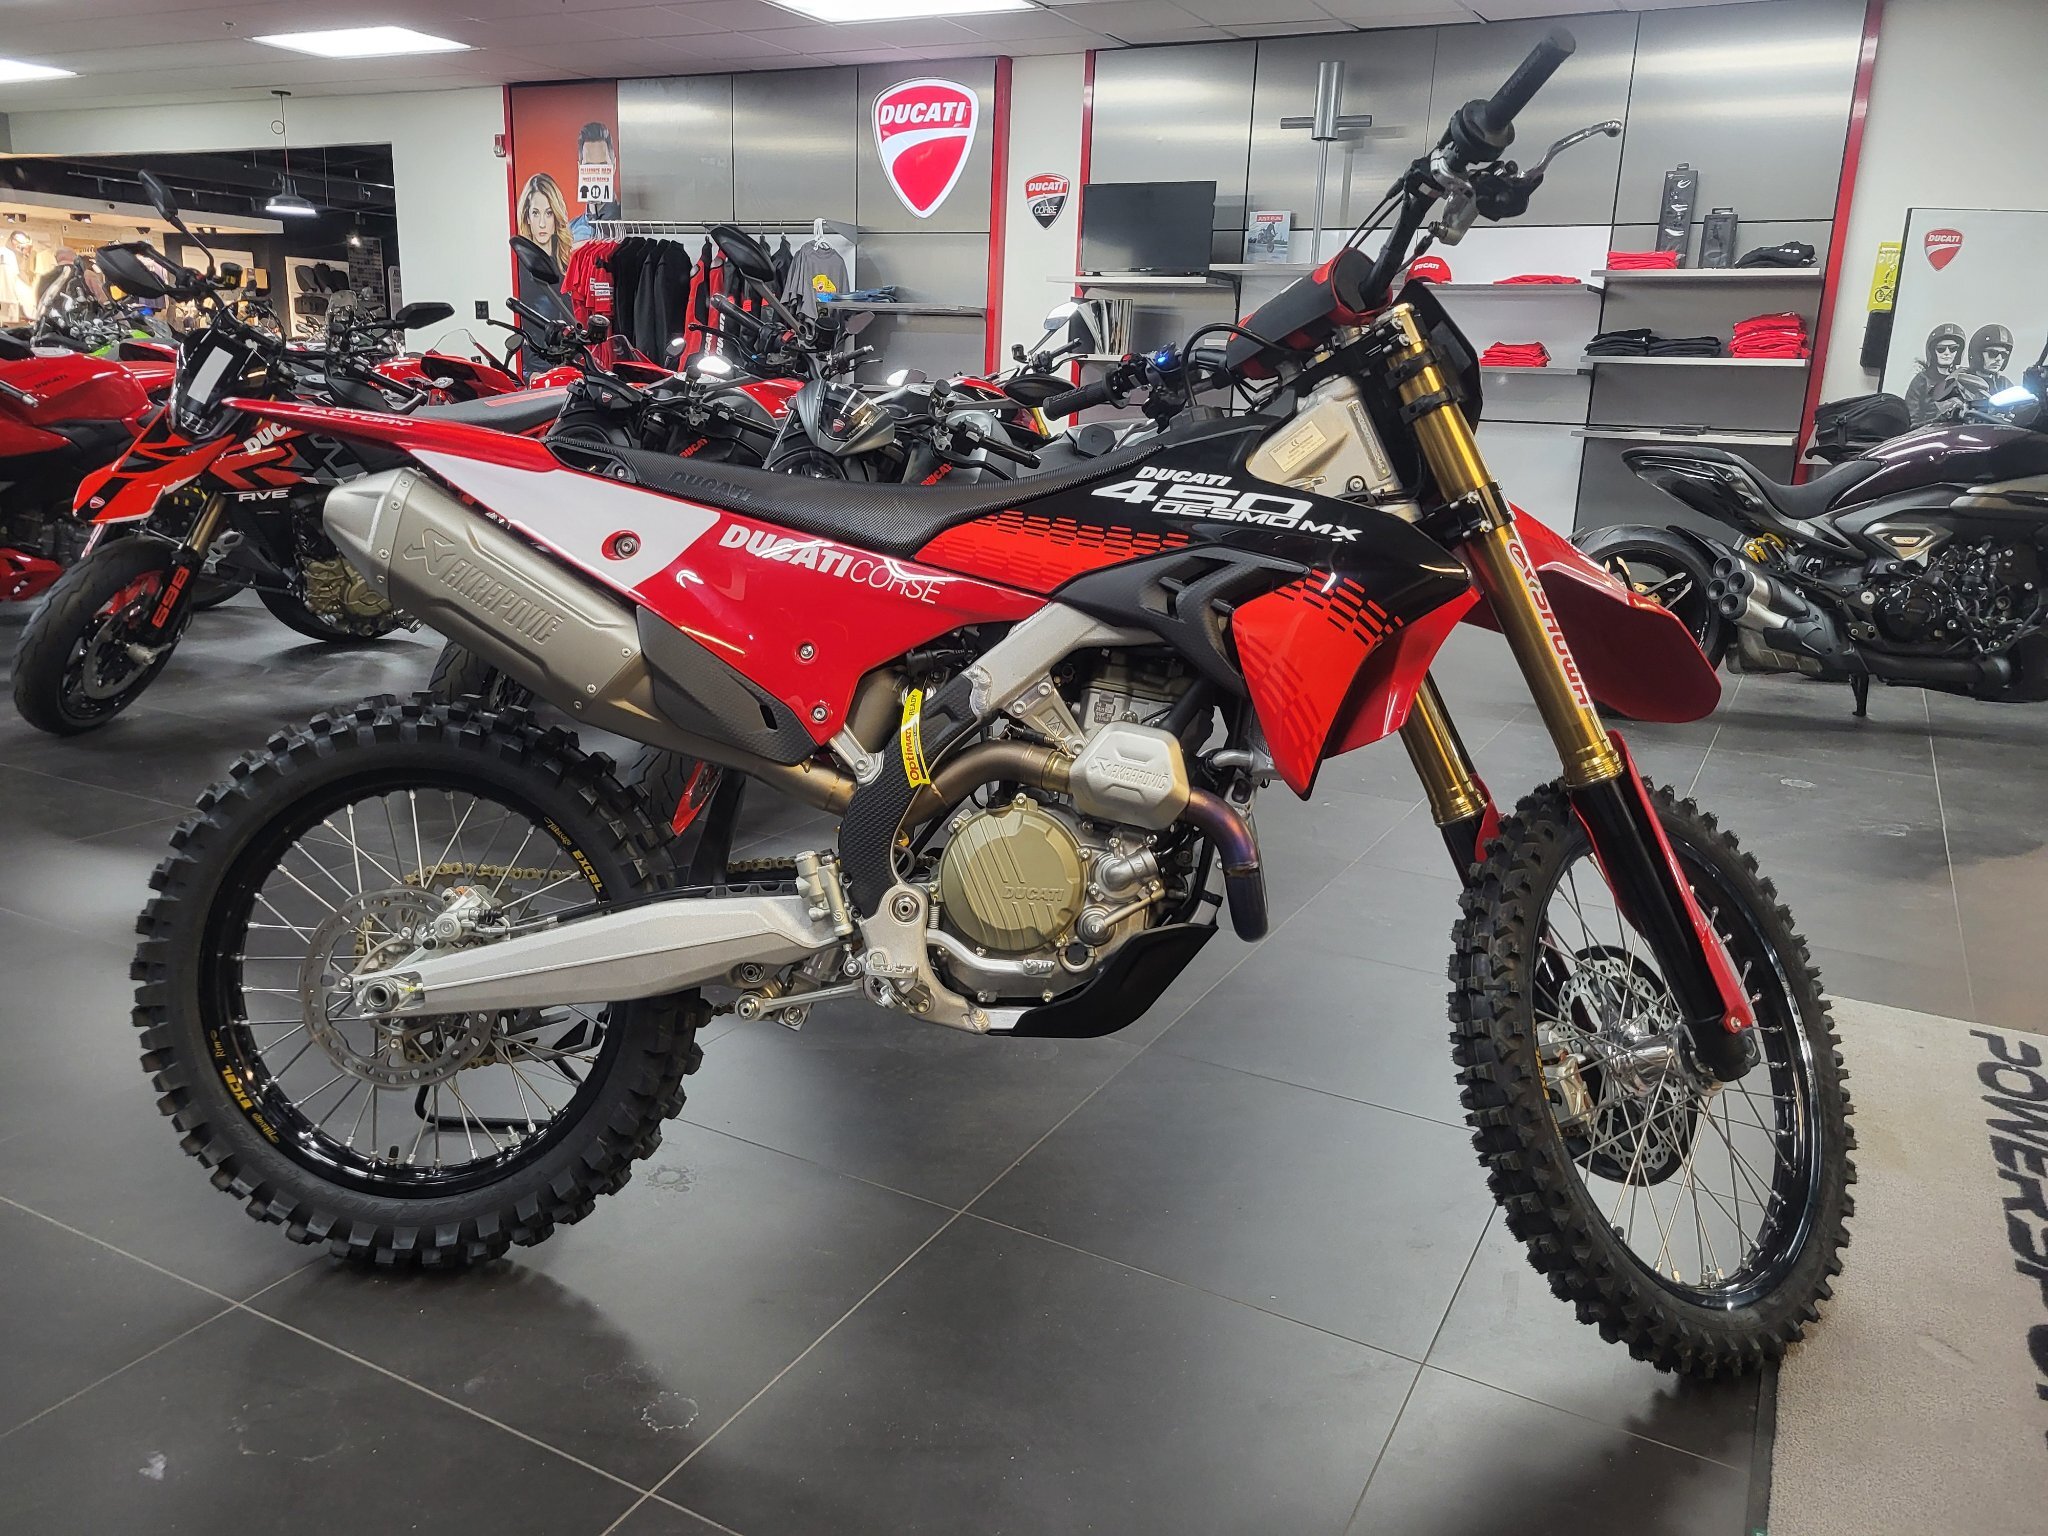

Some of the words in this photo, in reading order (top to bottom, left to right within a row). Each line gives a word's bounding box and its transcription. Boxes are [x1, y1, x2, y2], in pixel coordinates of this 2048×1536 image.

[880, 102, 966, 125] DUCATI
[1028, 180, 1064, 192] DUCATI
[1034, 205, 1058, 215] CORSE
[1928, 234, 1961, 243] DUCATI
[1414, 262, 1440, 271] DUCATI
[298, 407, 414, 427] FACTORY
[243, 421, 293, 454] DUC
[668, 471, 752, 500] DUCATI
[1135, 466, 1233, 487] DUCATI
[1091, 479, 1313, 520] 450
[1151, 501, 1300, 528] DESMO
[1298, 519, 1363, 542] MX
[718, 523, 854, 578] DUCATI
[849, 559, 946, 605] CORSE
[908, 694, 917, 716] READY
[572, 849, 603, 893] EXCEL
[1001, 886, 1065, 902] DUCATI
[222, 1065, 254, 1110] EXCEL
